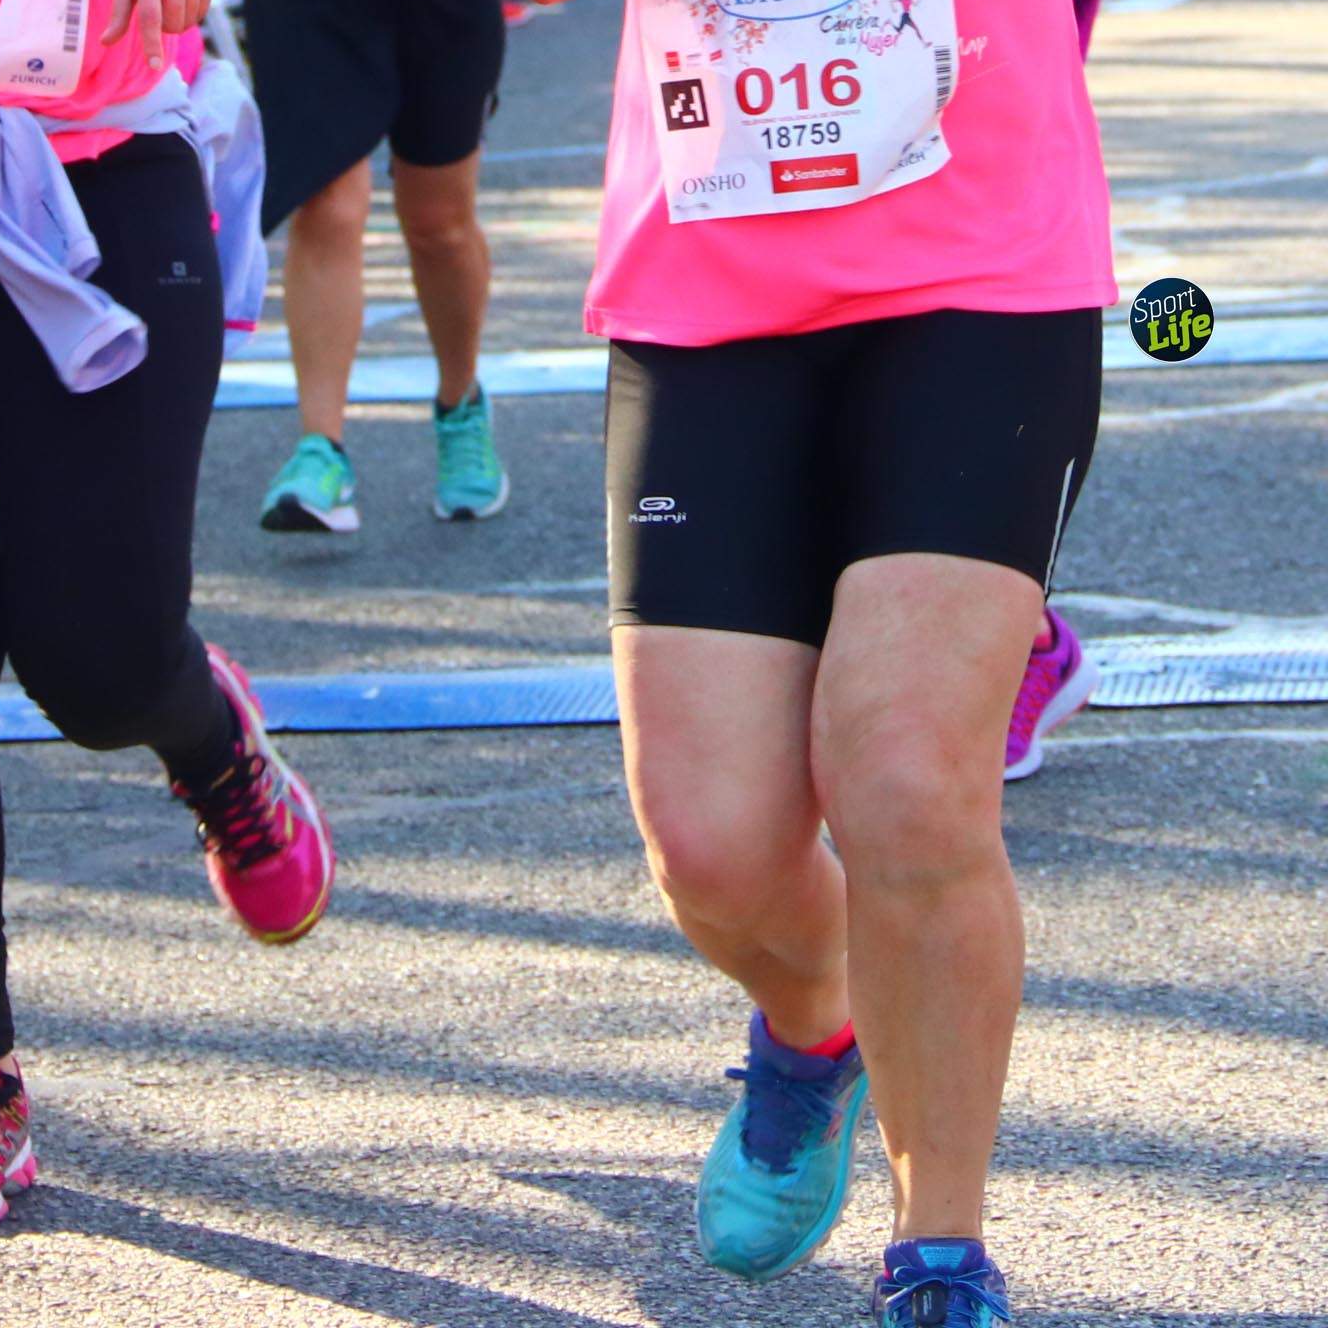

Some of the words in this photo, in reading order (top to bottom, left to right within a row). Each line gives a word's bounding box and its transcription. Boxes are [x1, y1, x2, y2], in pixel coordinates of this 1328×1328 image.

[9, 73, 58, 86] ZURICH
[734, 58, 862, 116] 016
[761, 121, 841, 150] 18759
[682, 172, 746, 195] OYSHO
[794, 167, 849, 180] Santander
